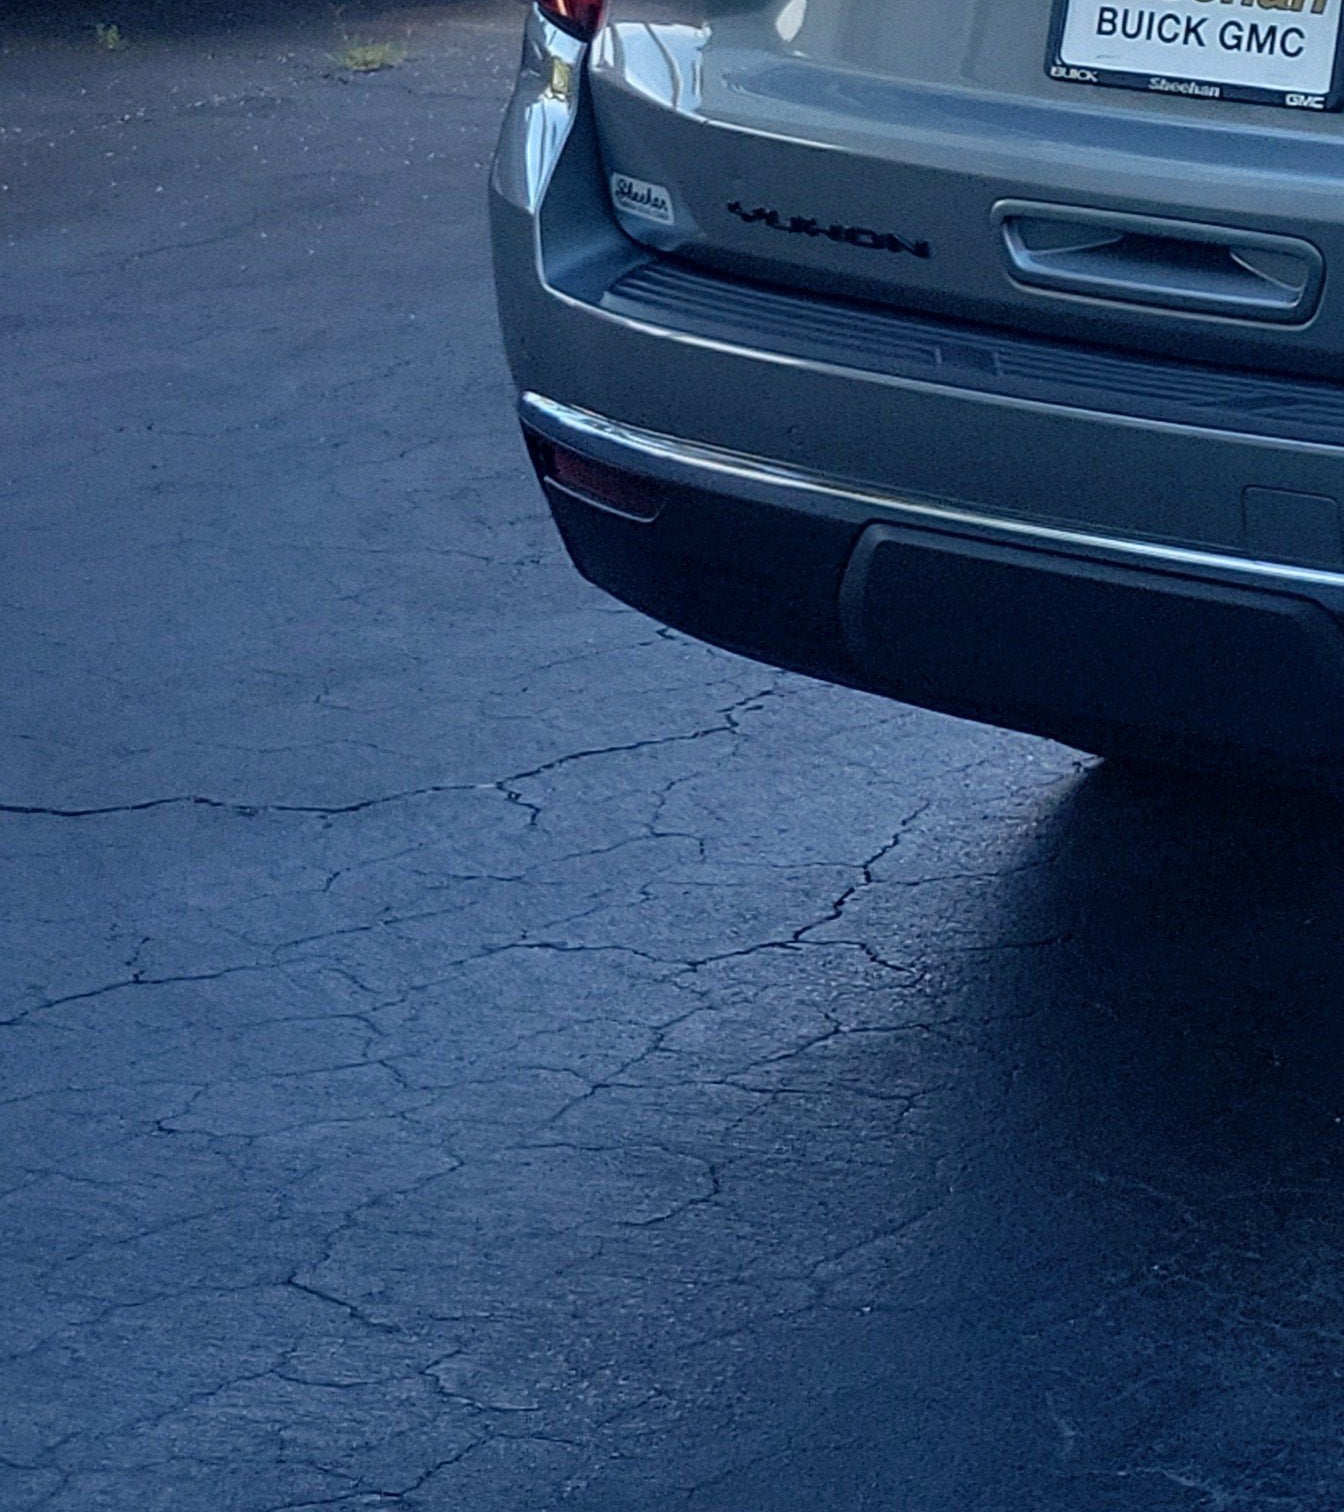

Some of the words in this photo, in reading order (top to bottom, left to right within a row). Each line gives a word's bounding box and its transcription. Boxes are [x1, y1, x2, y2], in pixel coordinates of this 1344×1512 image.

[1096, 6, 1210, 48] BUICK
[1218, 20, 1307, 59] GMC
[1050, 66, 1099, 83] BUICK
[1148, 77, 1221, 98] Sheehan
[1284, 93, 1326, 109] GMC
